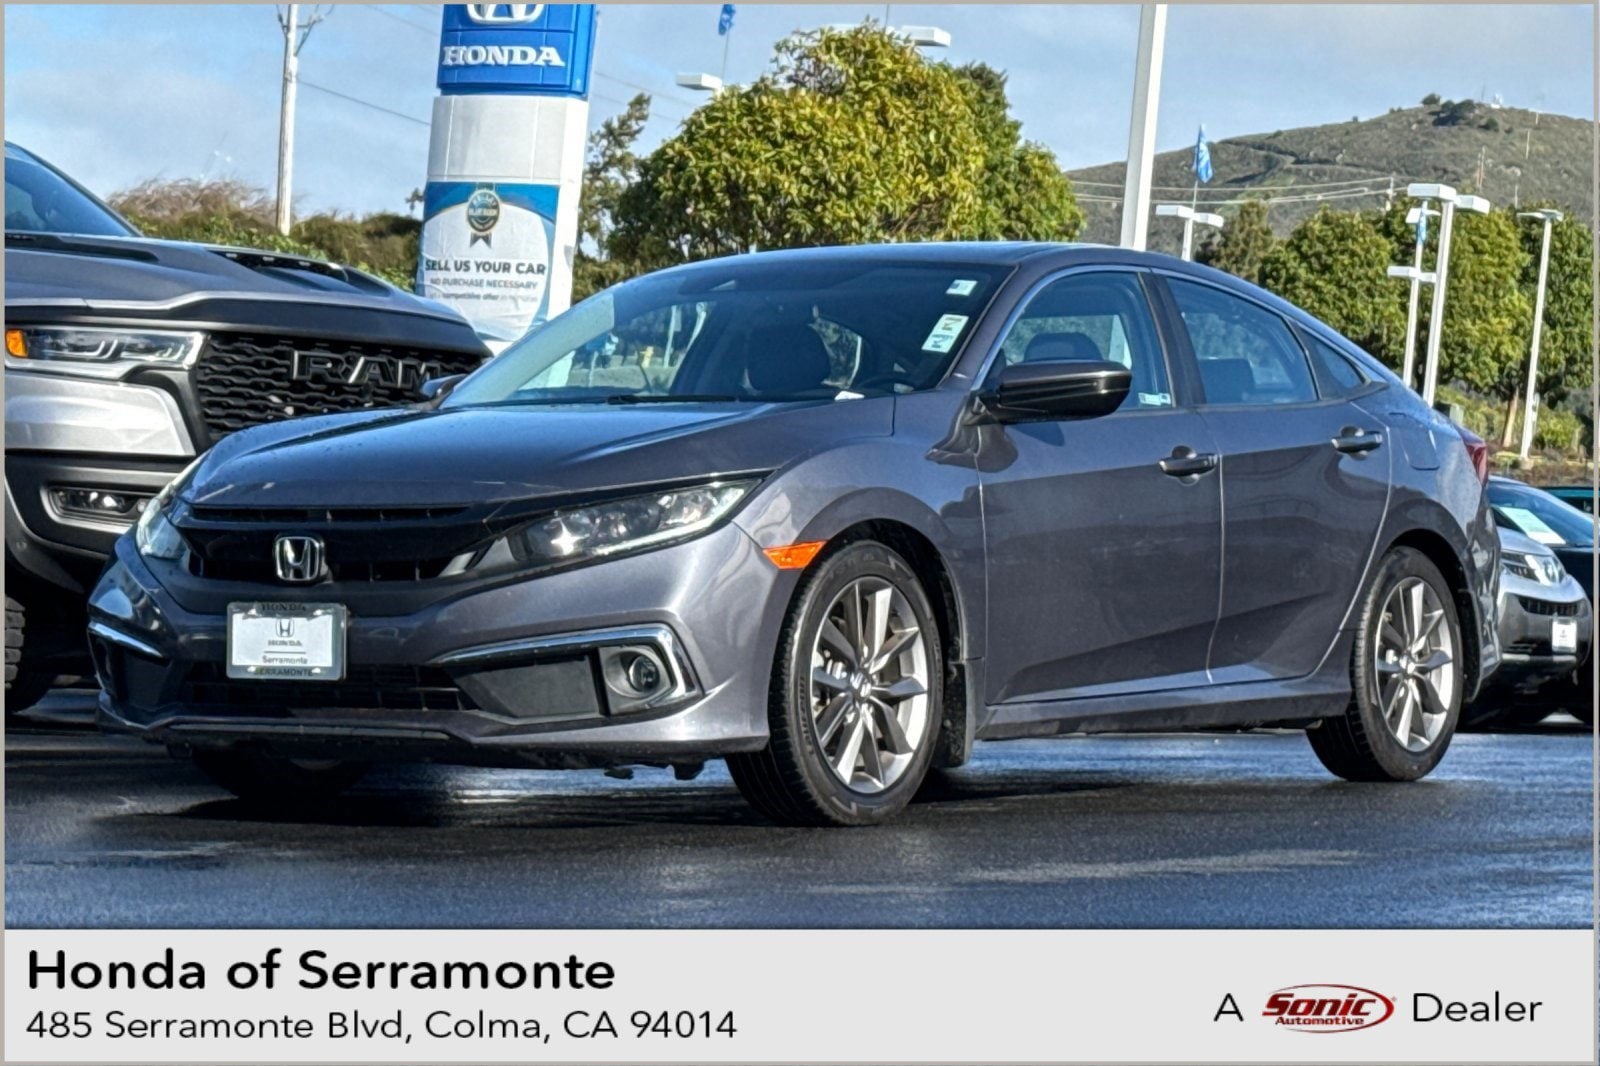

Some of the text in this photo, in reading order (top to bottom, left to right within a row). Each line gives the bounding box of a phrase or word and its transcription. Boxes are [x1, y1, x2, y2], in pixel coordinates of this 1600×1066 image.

[442, 45, 566, 67] HONDA
[425, 260, 546, 275] SELL US YOUR CAR
[430, 278, 538, 289] NO PURCHASE NECESSARY
[483, 292, 499, 300] offer
[292, 350, 441, 388] RAM
[262, 603, 307, 612] HONDA
[262, 655, 308, 665] Serramonte
